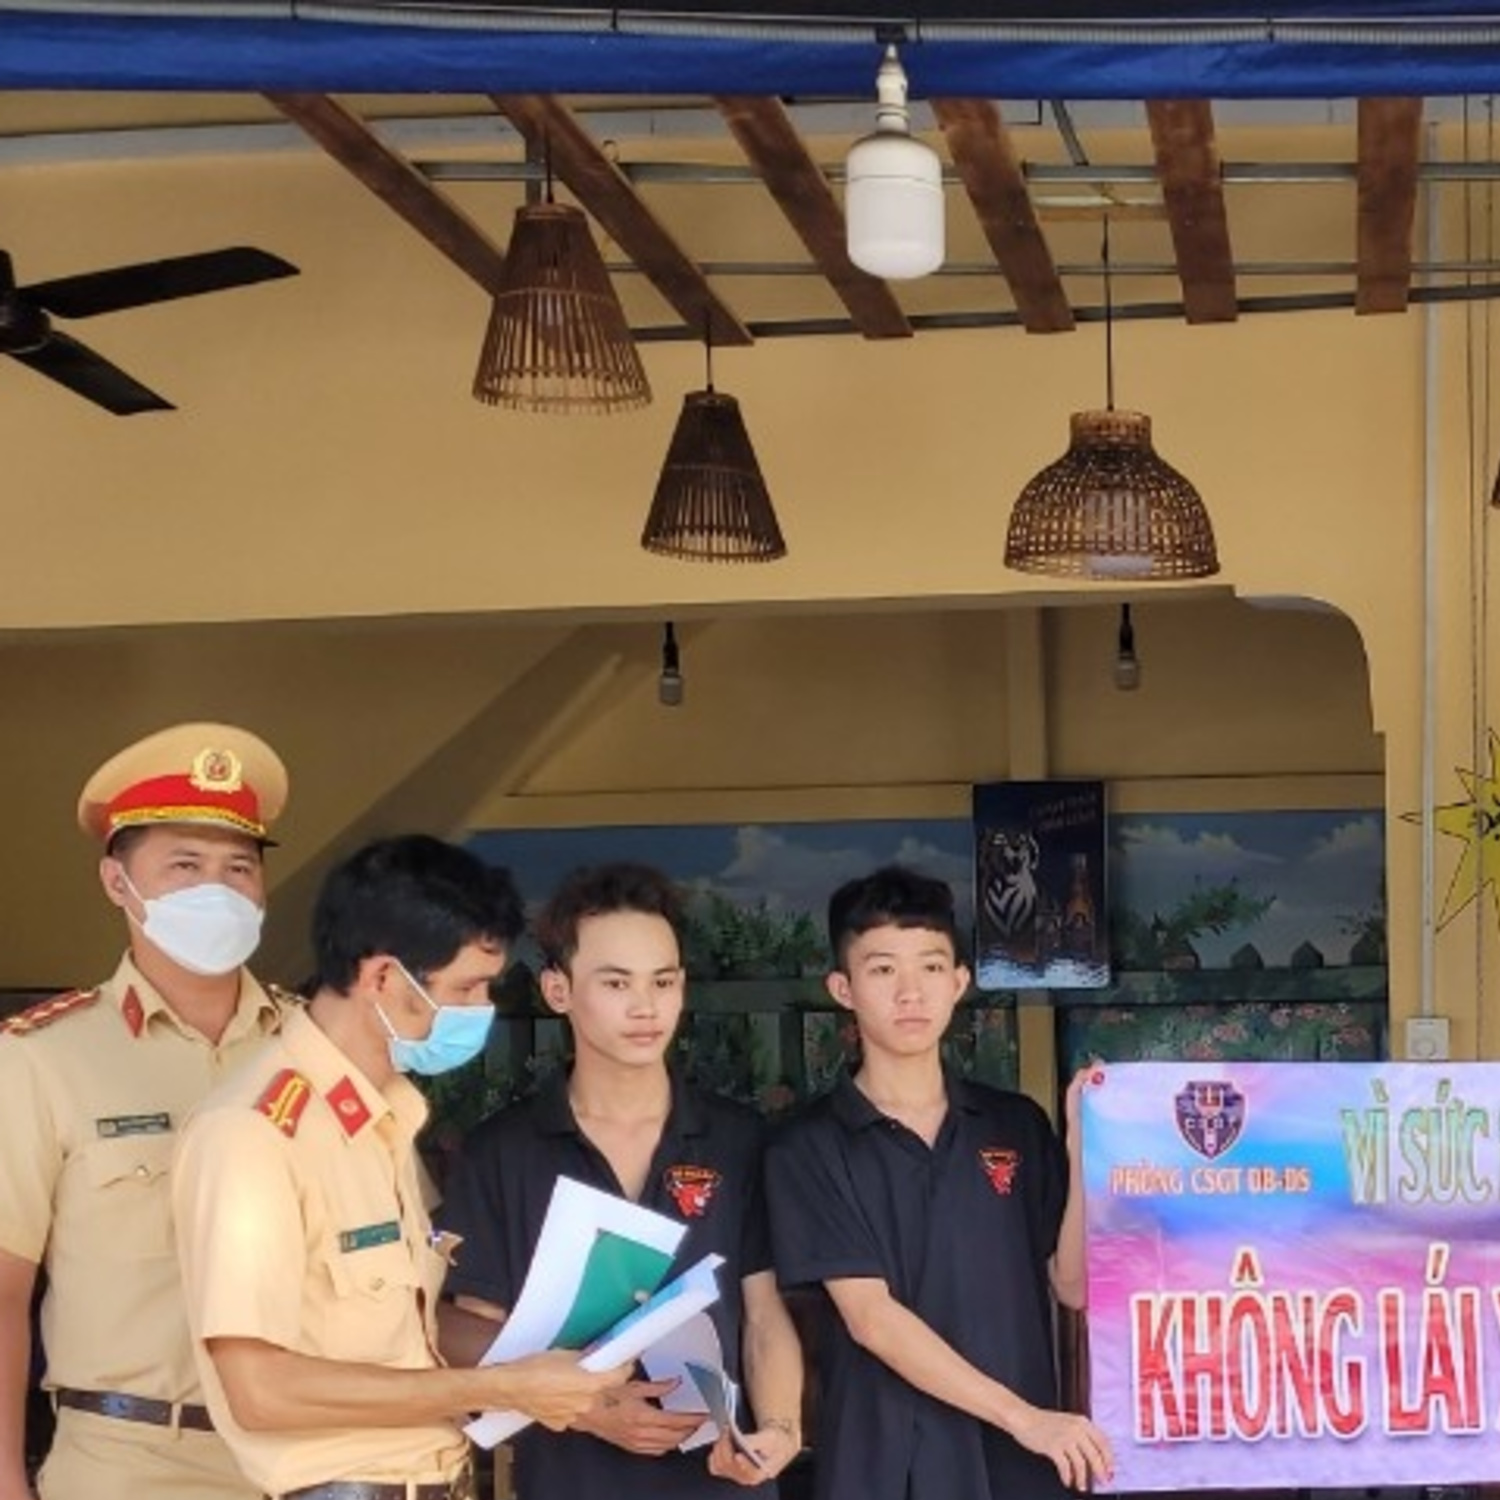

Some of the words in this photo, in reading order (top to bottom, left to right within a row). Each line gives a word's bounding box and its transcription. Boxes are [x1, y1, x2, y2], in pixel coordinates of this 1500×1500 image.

[1111, 1158, 1184, 1196] PHÒNG
[1190, 1167, 1242, 1195] CSGT
[1339, 1080, 1389, 1205] VÌ
[1400, 1080, 1491, 1204] SỨC
[1132, 1246, 1366, 1443] KHÔNG
[1382, 1243, 1482, 1435] LÁI
